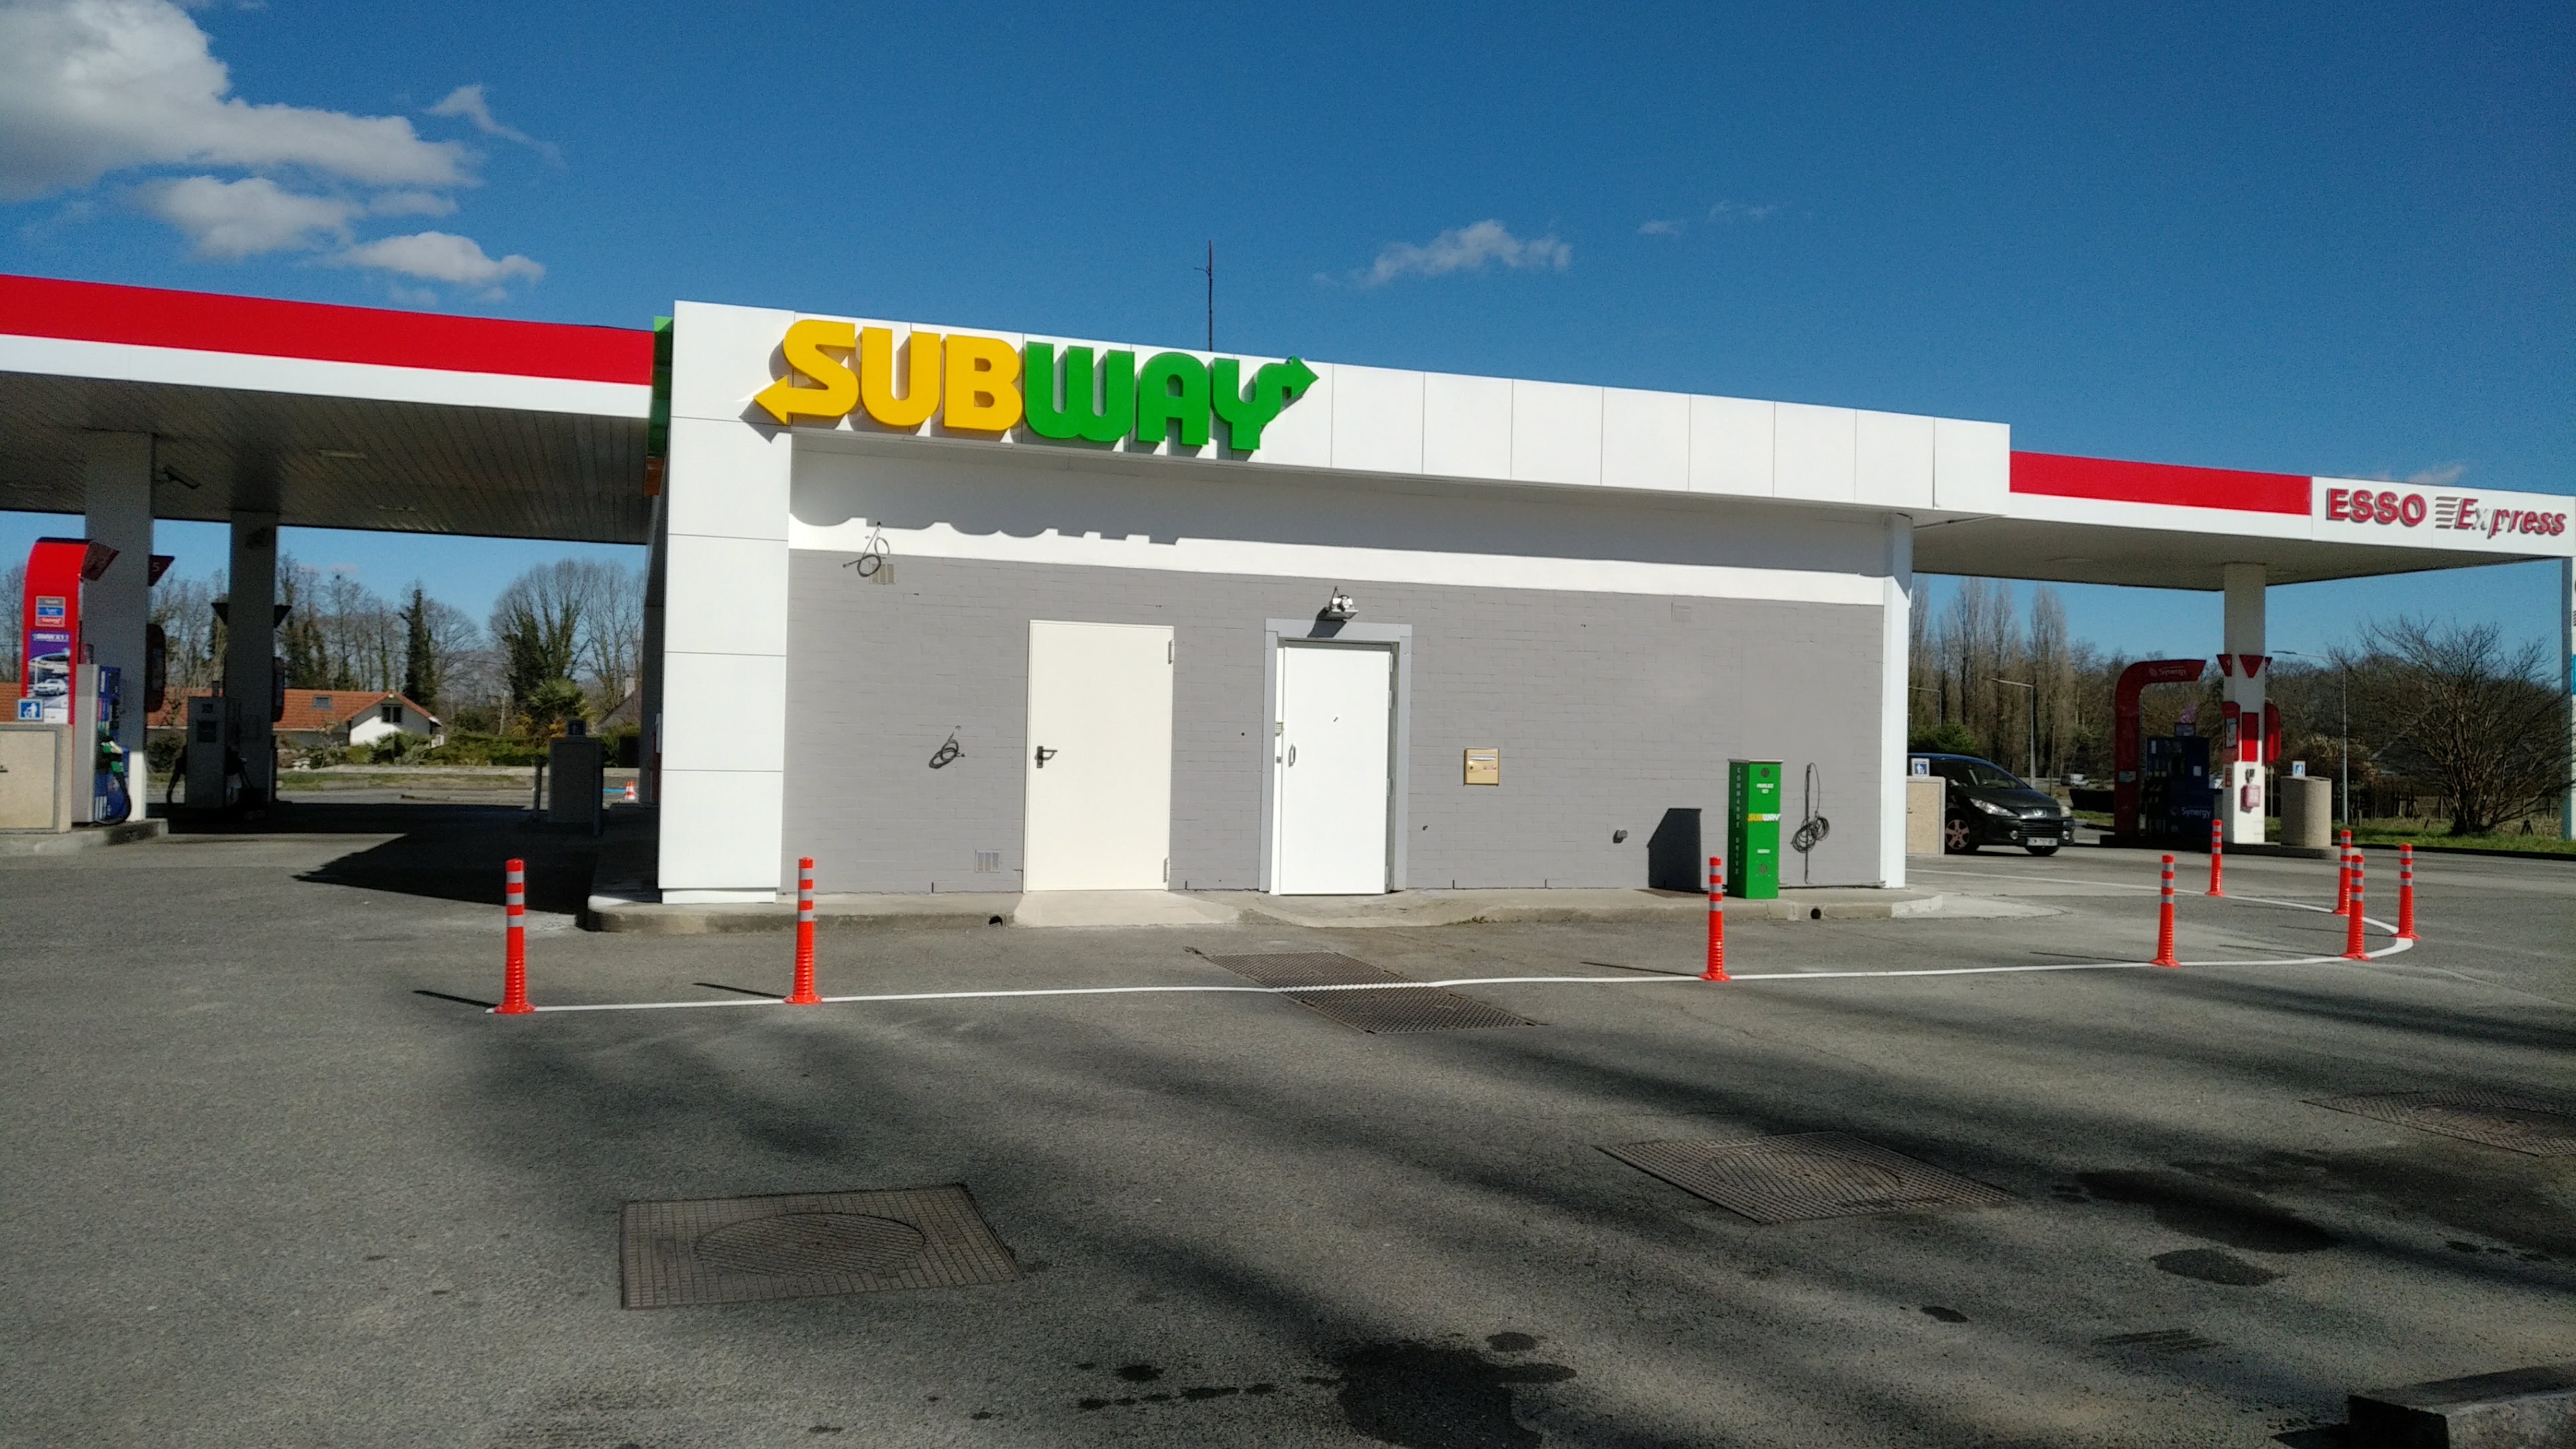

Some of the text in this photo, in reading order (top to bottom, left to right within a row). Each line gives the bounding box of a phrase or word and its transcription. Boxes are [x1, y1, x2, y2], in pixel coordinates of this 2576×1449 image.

[753, 319, 1320, 450] SUBWAY
[2326, 488, 2568, 539] ESSO Express
[1748, 813, 1781, 822] SUBWAY
[2181, 806, 2212, 819] Synergy
